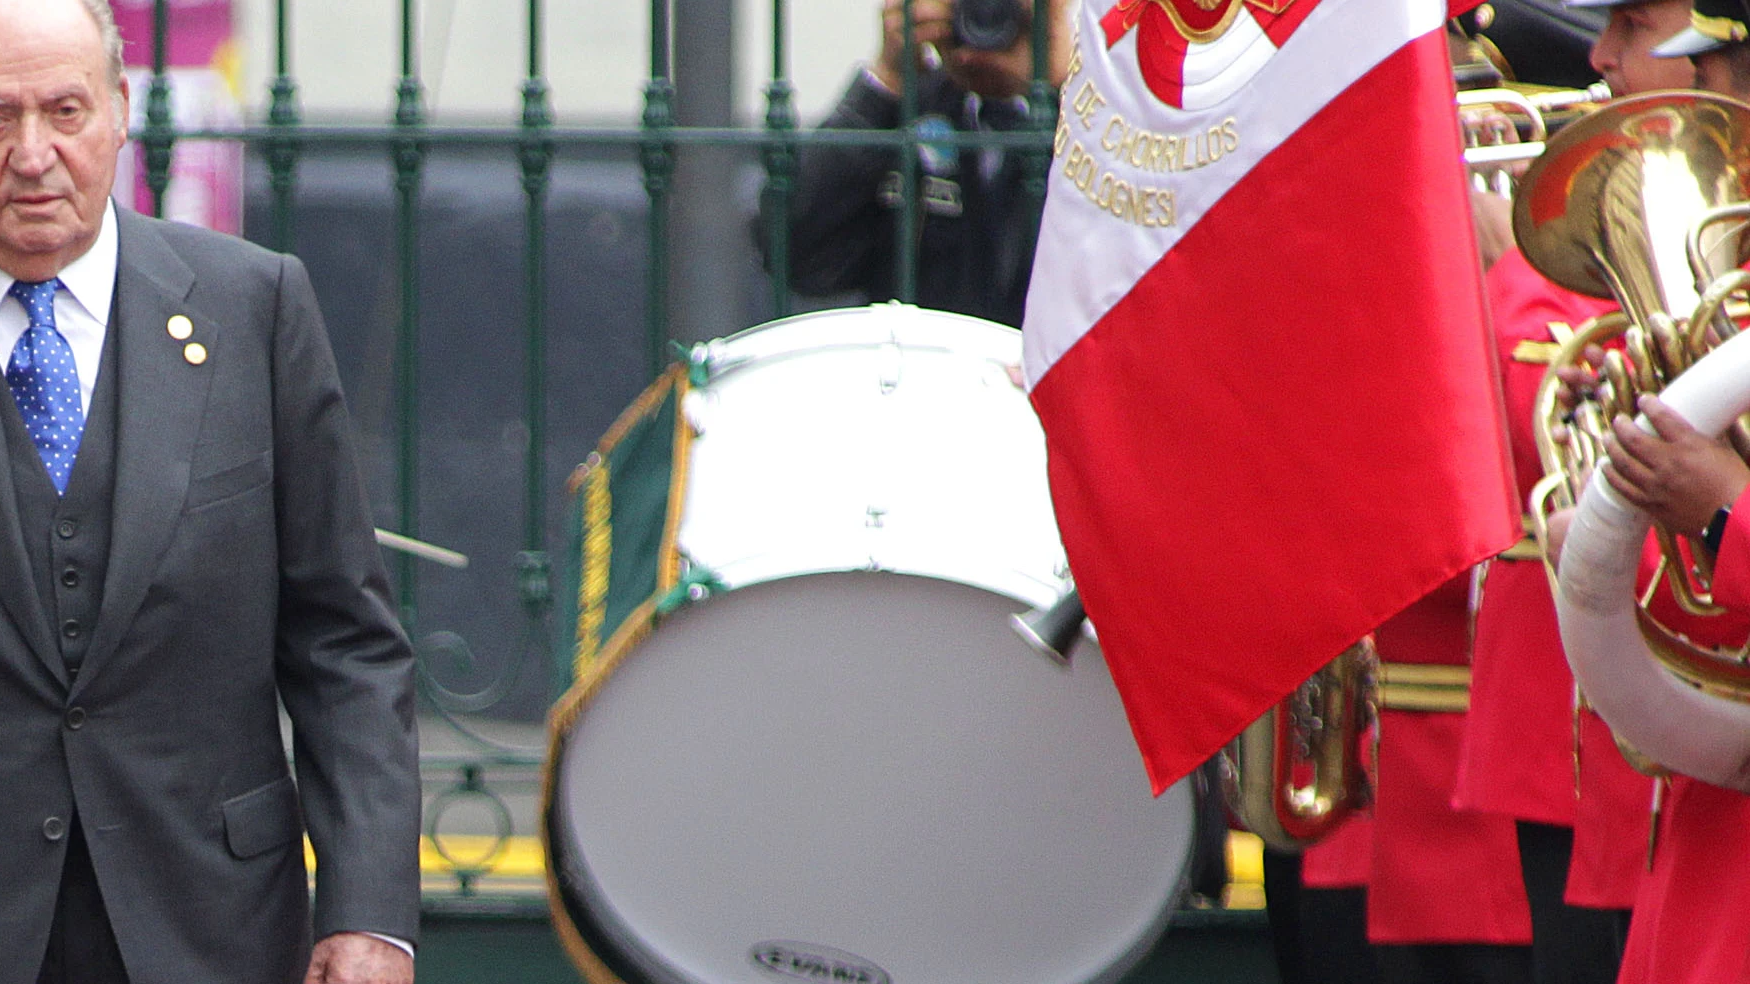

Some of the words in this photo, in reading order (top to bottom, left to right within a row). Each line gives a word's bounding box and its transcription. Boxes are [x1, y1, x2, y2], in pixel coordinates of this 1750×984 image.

[1072, 78, 1106, 130] DE
[1101, 114, 1239, 173] CHORRILLOS
[1063, 140, 1178, 229] BOLOGNESI
